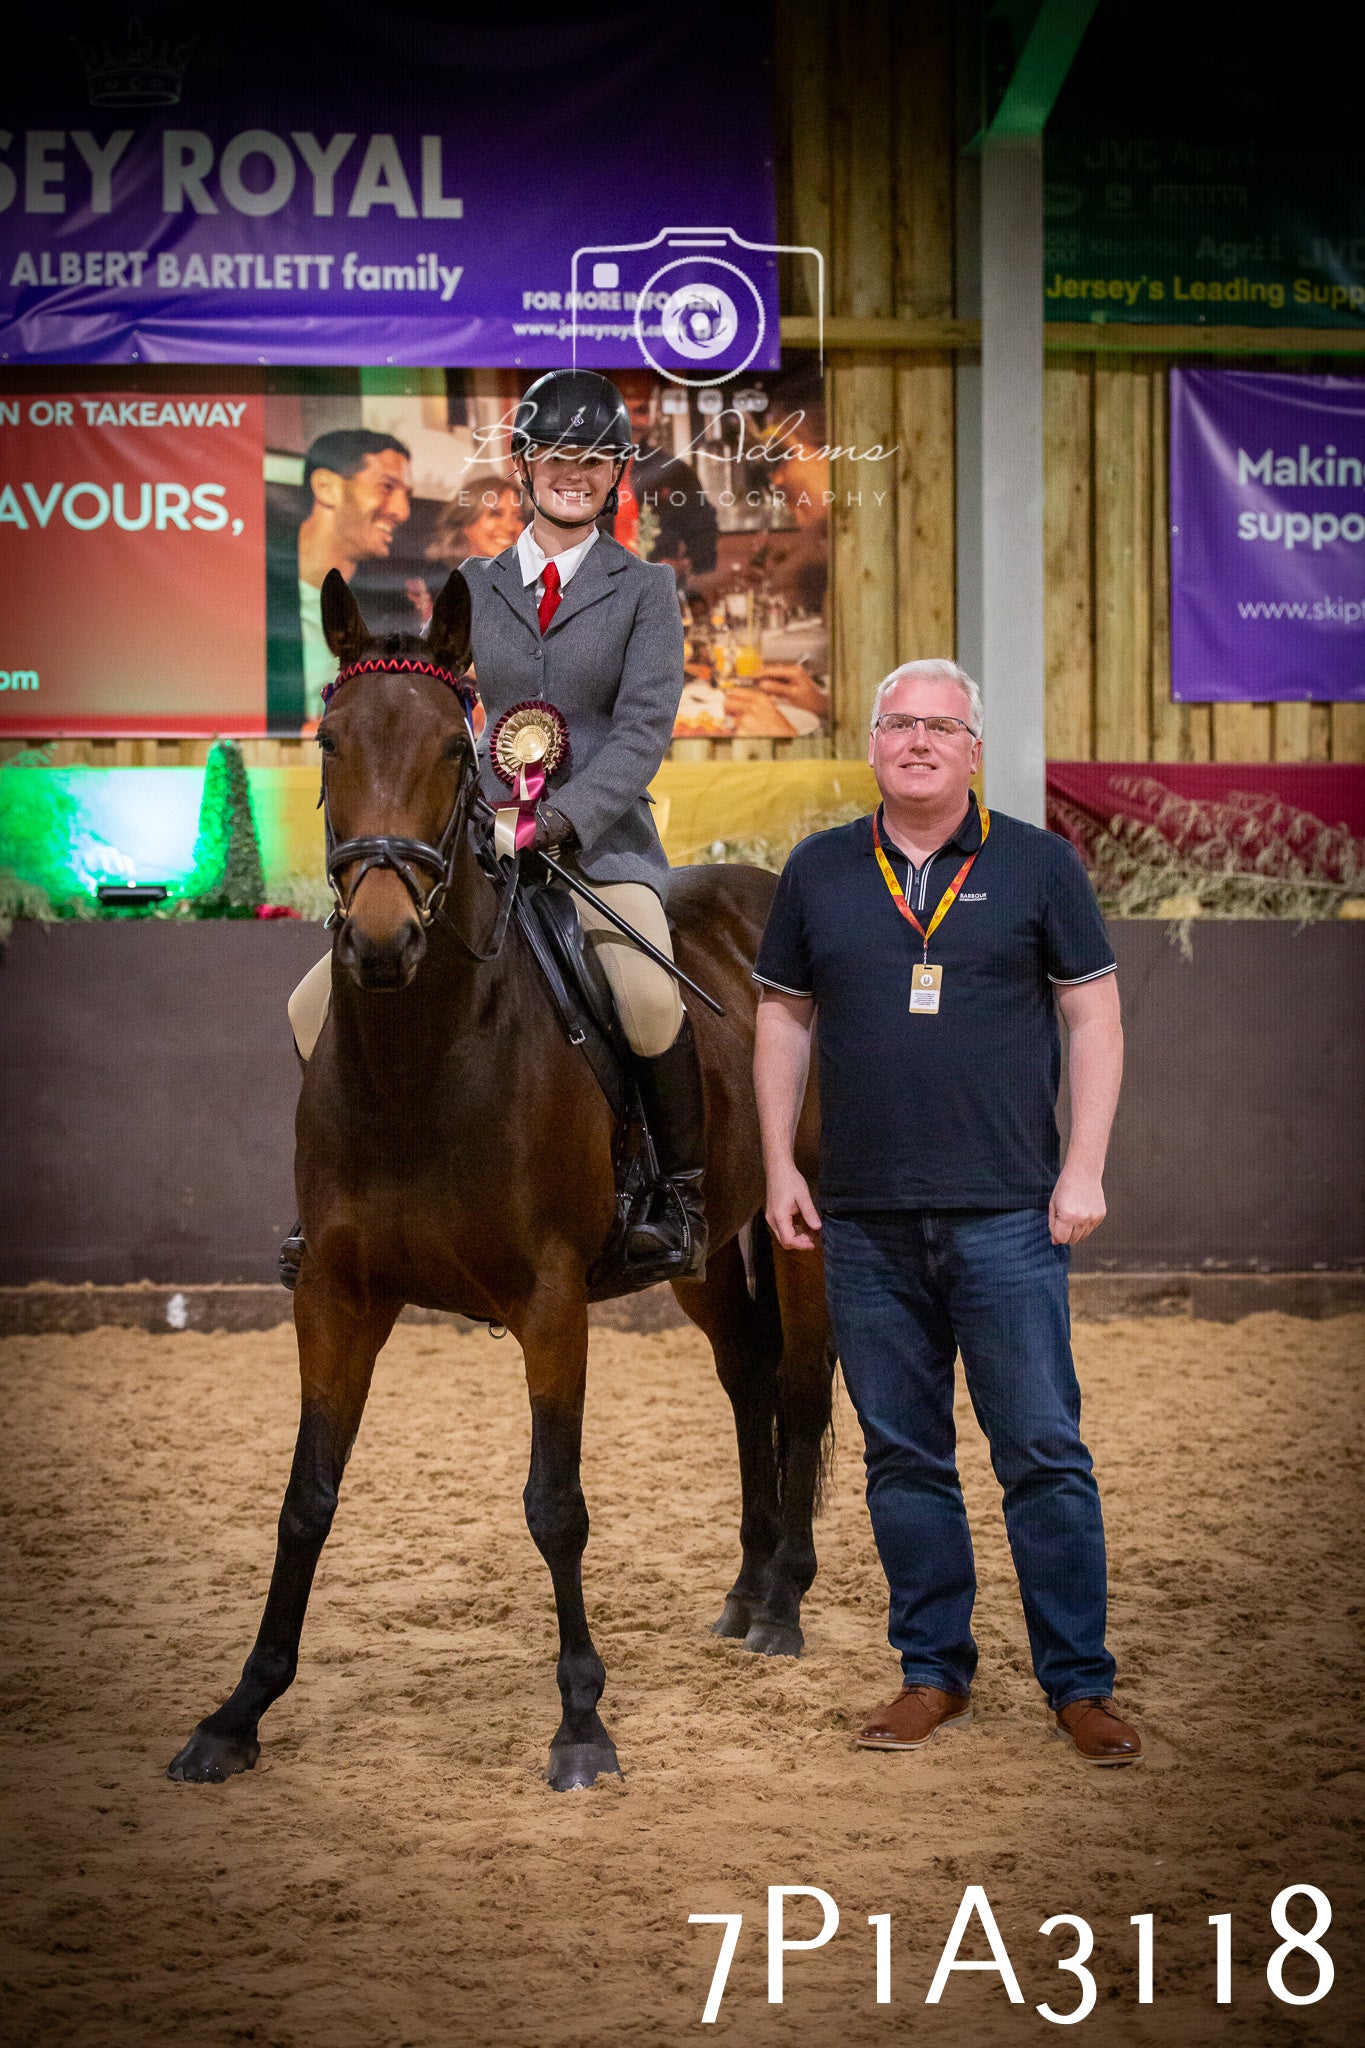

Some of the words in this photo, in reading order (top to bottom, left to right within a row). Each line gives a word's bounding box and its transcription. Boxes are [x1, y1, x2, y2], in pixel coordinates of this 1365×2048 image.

[161, 129, 464, 219] ROYAL
[9, 251, 148, 287] ALBERT
[156, 253, 335, 290] BARTLETT
[341, 252, 464, 301] family
[1045, 274, 1165, 306] Jersey's
[1173, 275, 1286, 309] Leading
[1293, 278, 1365, 311] Supp
[522, 291, 562, 311] FOR
[564, 291, 622, 311] MORE
[28, 400, 75, 427] OR
[81, 401, 248, 428] TAKEAWAY
[1238, 444, 1365, 492] Makin
[0, 482, 245, 537] AVOURS,
[1237, 511, 1365, 551] suppo
